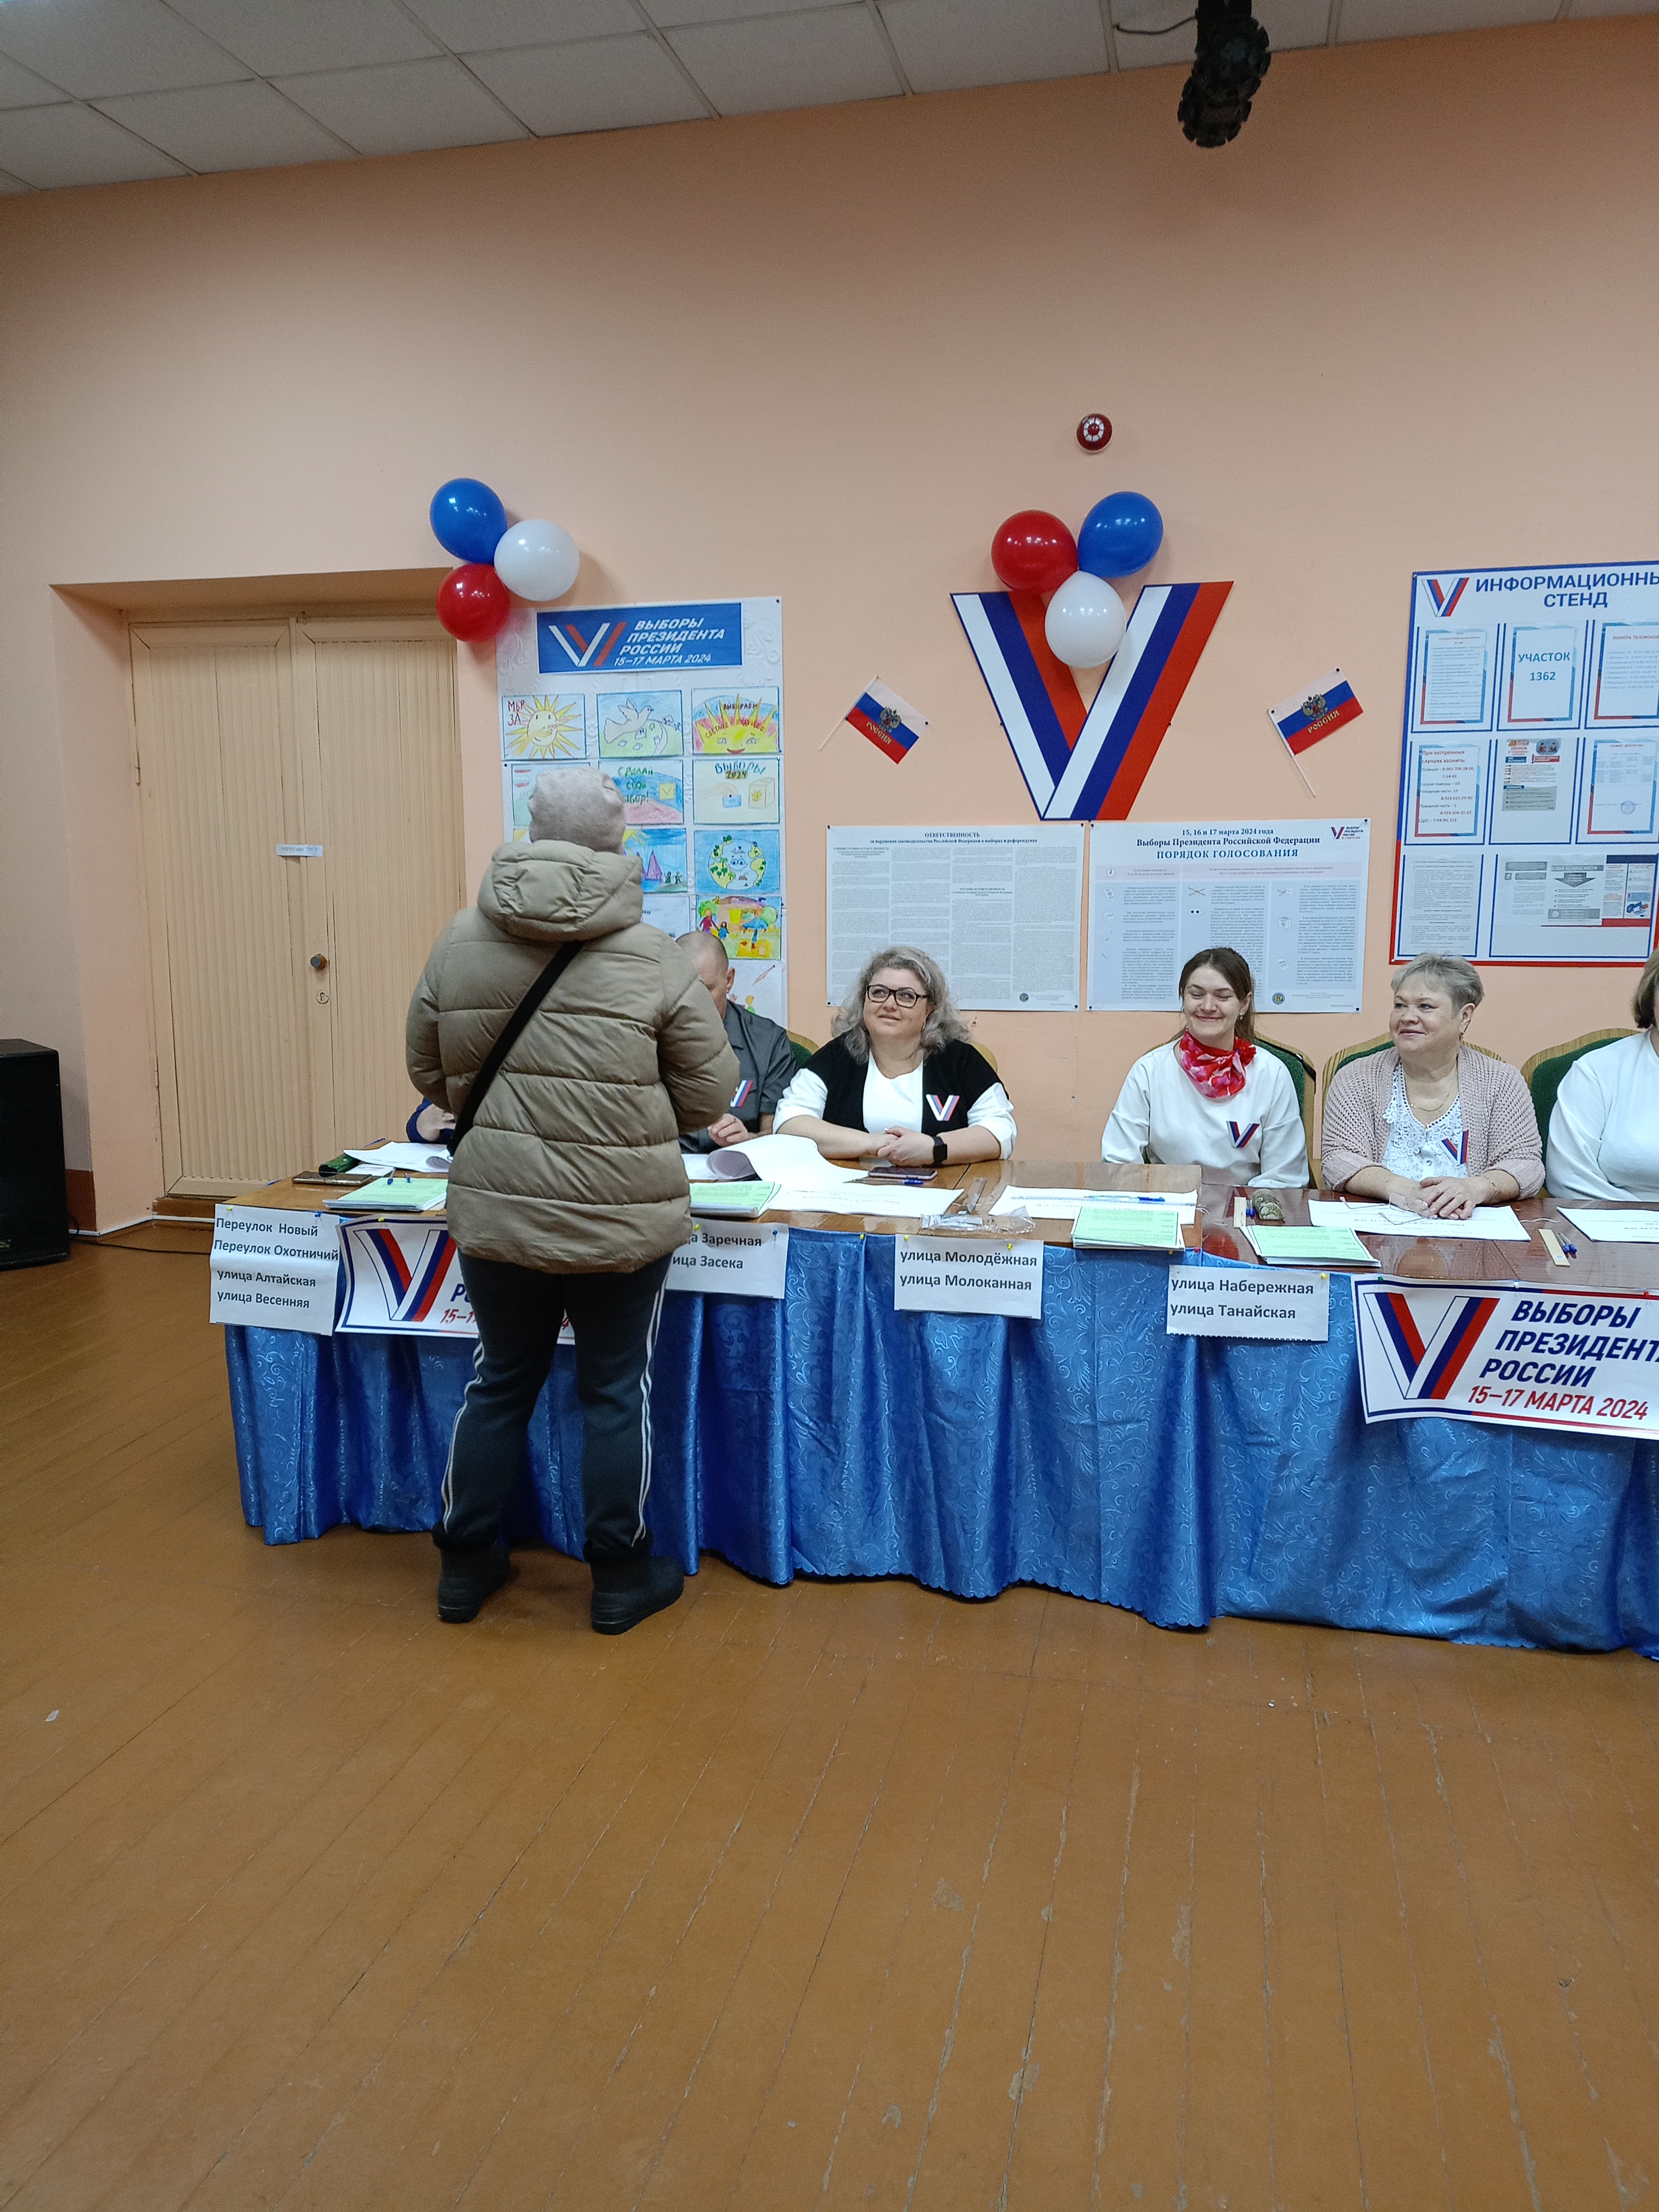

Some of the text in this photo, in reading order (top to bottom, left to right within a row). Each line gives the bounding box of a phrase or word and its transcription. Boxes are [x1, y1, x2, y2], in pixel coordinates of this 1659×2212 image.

[1544, 592, 1608, 608] СТЕНД
[634, 618, 704, 630] ВЫБОРЫ
[627, 629, 725, 643] ПРЕЗИДЕНТА
[619, 643, 683, 655] РОССИИ
[645, 655, 683, 665] МАРТА
[685, 653, 711, 663] 2024
[1518, 652, 1570, 662] УЧАСТОК
[1530, 672, 1556, 681] 1362
[1308, 709, 1340, 733] РОССИЯ
[866, 721, 892, 745] РОССИЯ
[715, 762, 765, 774] ВЫБОРЫ
[726, 770, 748, 779] 2024
[624, 790, 649, 806] ЫБОР!
[1137, 839, 1170, 848] Выборы
[1172, 838, 1220, 848] Президента
[1273, 837, 1320, 845] Федерации
[1157, 849, 1298, 859] ПОРЯДОК ГОЛОСОВАНИЯ
[216, 1218, 318, 1237] Переулок Новый
[702, 1233, 762, 1247] Заречная
[214, 1239, 338, 1261] Переулок Охотничий
[673, 1256, 743, 1269] ица Засека
[900, 1251, 1037, 1266] улица Молодёжная
[217, 1270, 316, 1287] улица Алтайская
[900, 1275, 1031, 1290] улица Молоканная
[1171, 1279, 1314, 1294] улица Набережная
[217, 1292, 310, 1308] улица Весенняя
[1171, 1304, 1295, 1318] улица Танайская
[1511, 1300, 1642, 1328] ВЫБОРЫ
[1495, 1330, 1659, 1362] ПРЕЗИДЕНТ
[1479, 1358, 1597, 1387] РОССИИ
[1524, 1391, 1594, 1415] МАРТА
[1596, 1397, 1648, 1420] 2024
